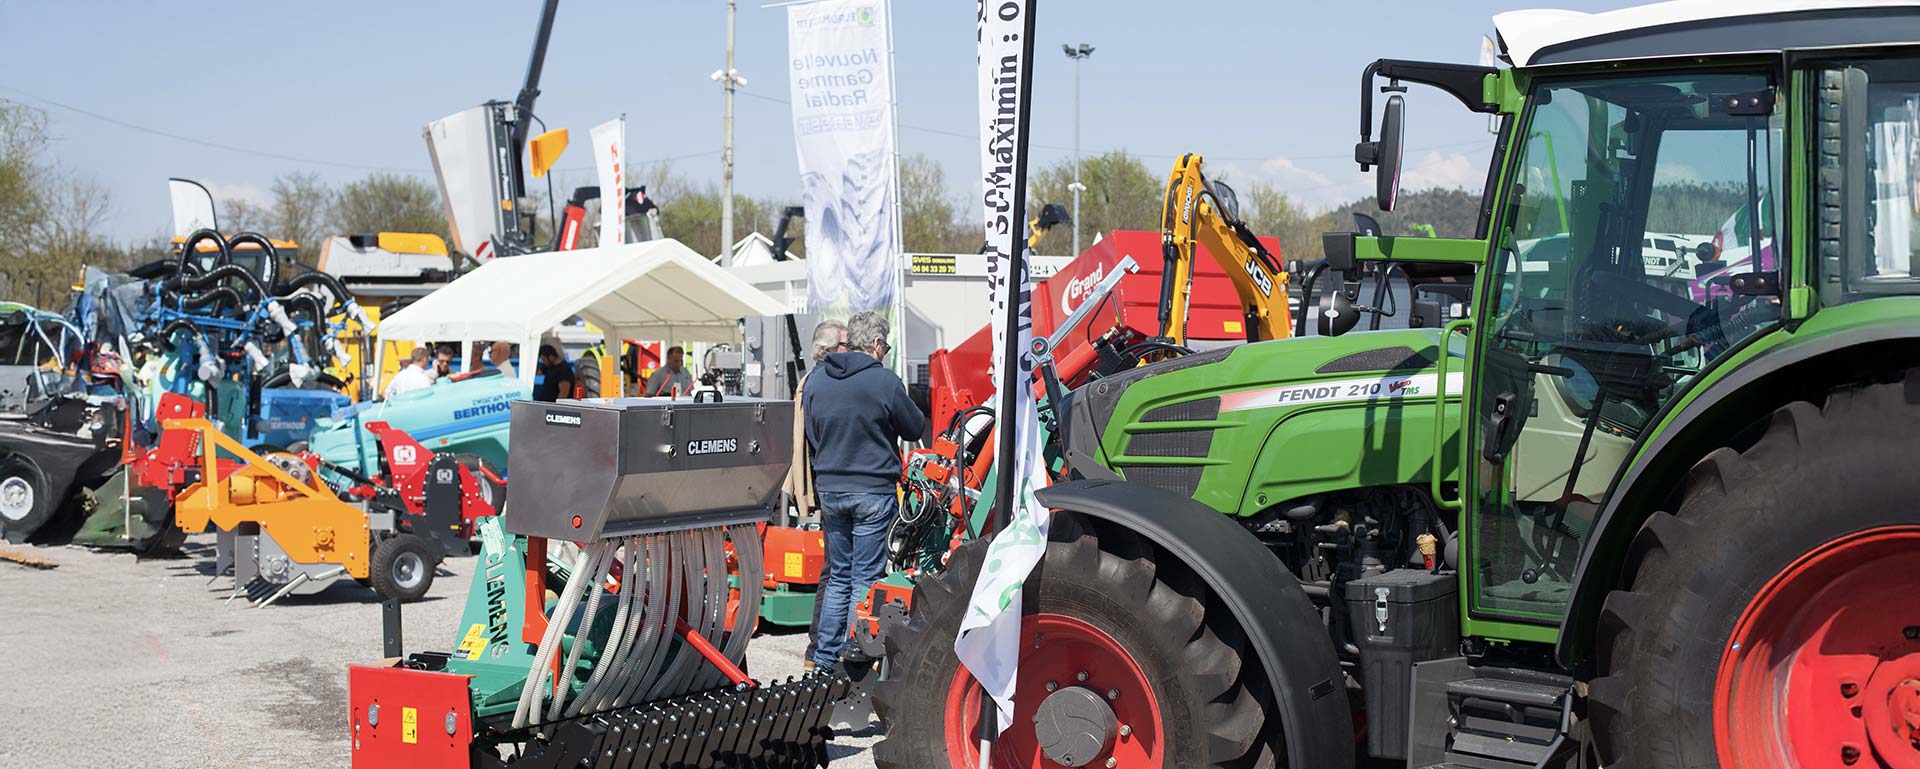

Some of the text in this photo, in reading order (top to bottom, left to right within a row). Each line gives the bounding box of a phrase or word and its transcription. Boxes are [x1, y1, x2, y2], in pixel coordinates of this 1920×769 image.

[1071, 261, 1103, 299] Grand
[1245, 260, 1273, 298] JCB
[1278, 383, 1381, 402] FENDT 210
[1401, 387, 1420, 396] TMS
[546, 414, 581, 425] CLEMENS
[688, 438, 737, 455] CLEMENS
[485, 552, 510, 660] CLEMENS
